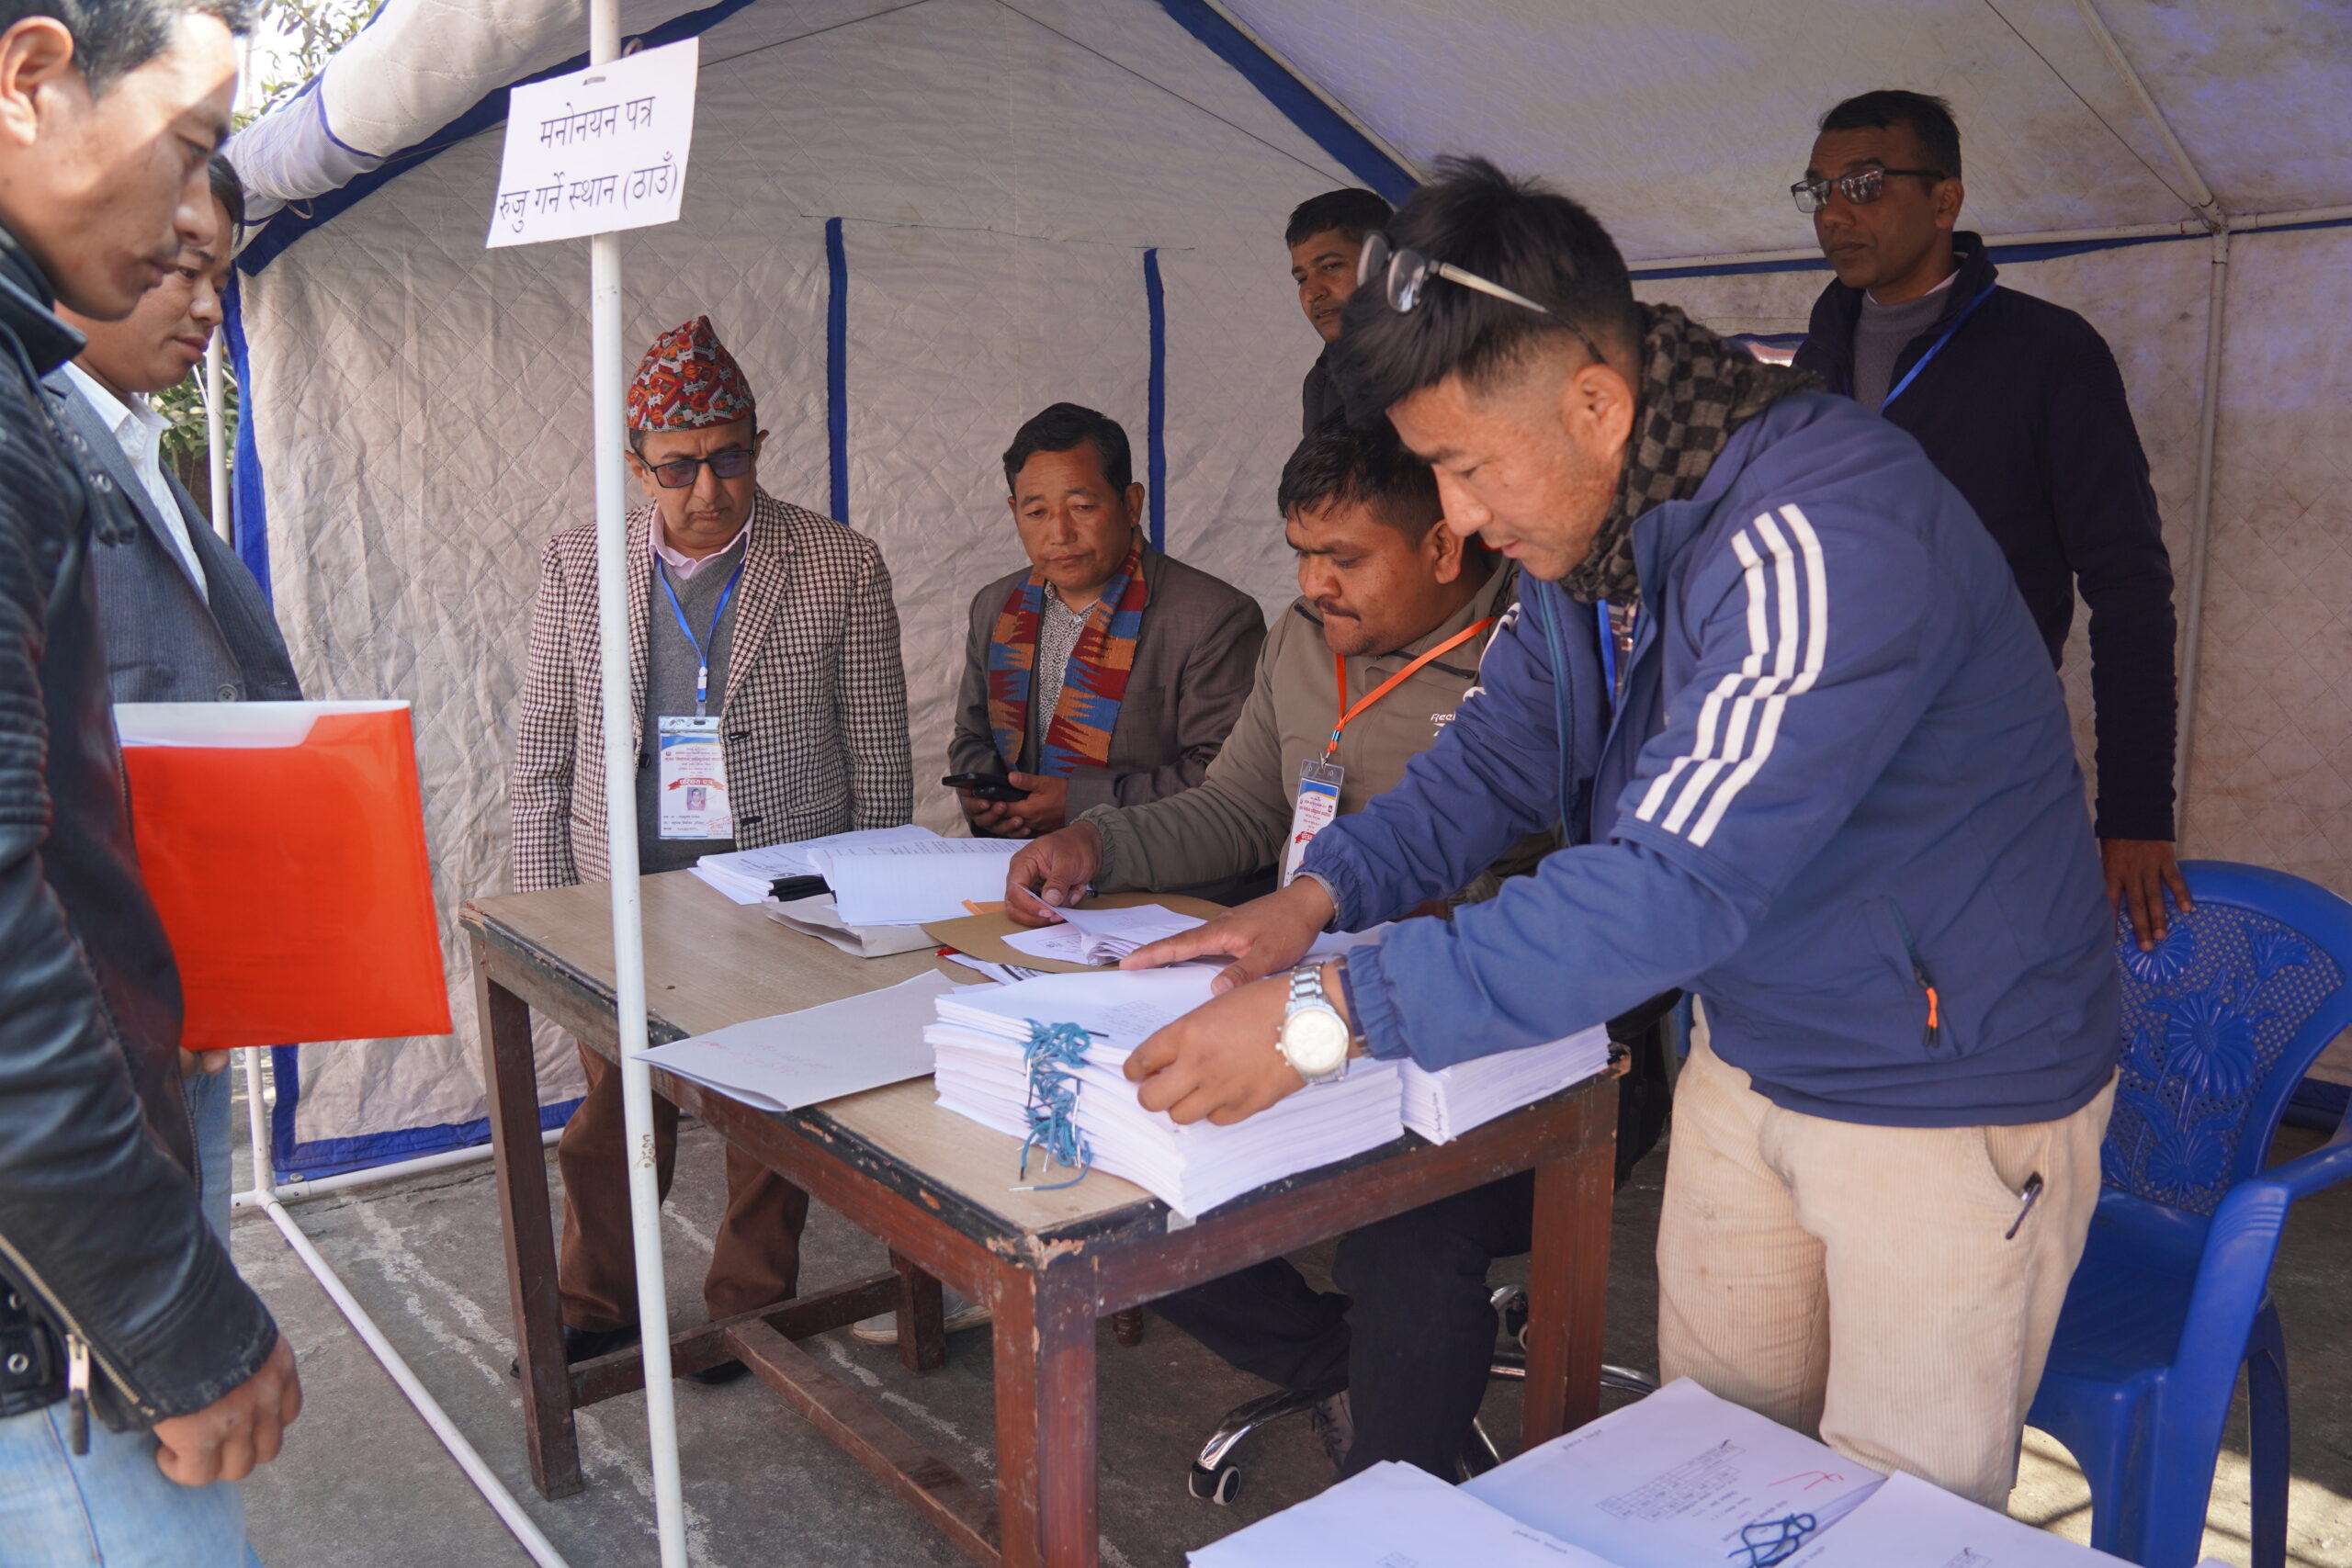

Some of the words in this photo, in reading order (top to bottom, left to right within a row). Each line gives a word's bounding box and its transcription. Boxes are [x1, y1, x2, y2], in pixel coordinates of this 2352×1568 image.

[540, 102, 620, 149] मनोनयन
[626, 95, 656, 131] पत्र
[499, 189, 530, 233] रुजु
[535, 172, 566, 215] गर्ने
[569, 174, 619, 210] स्थान
[623, 150, 679, 210] (ठाउँ)
